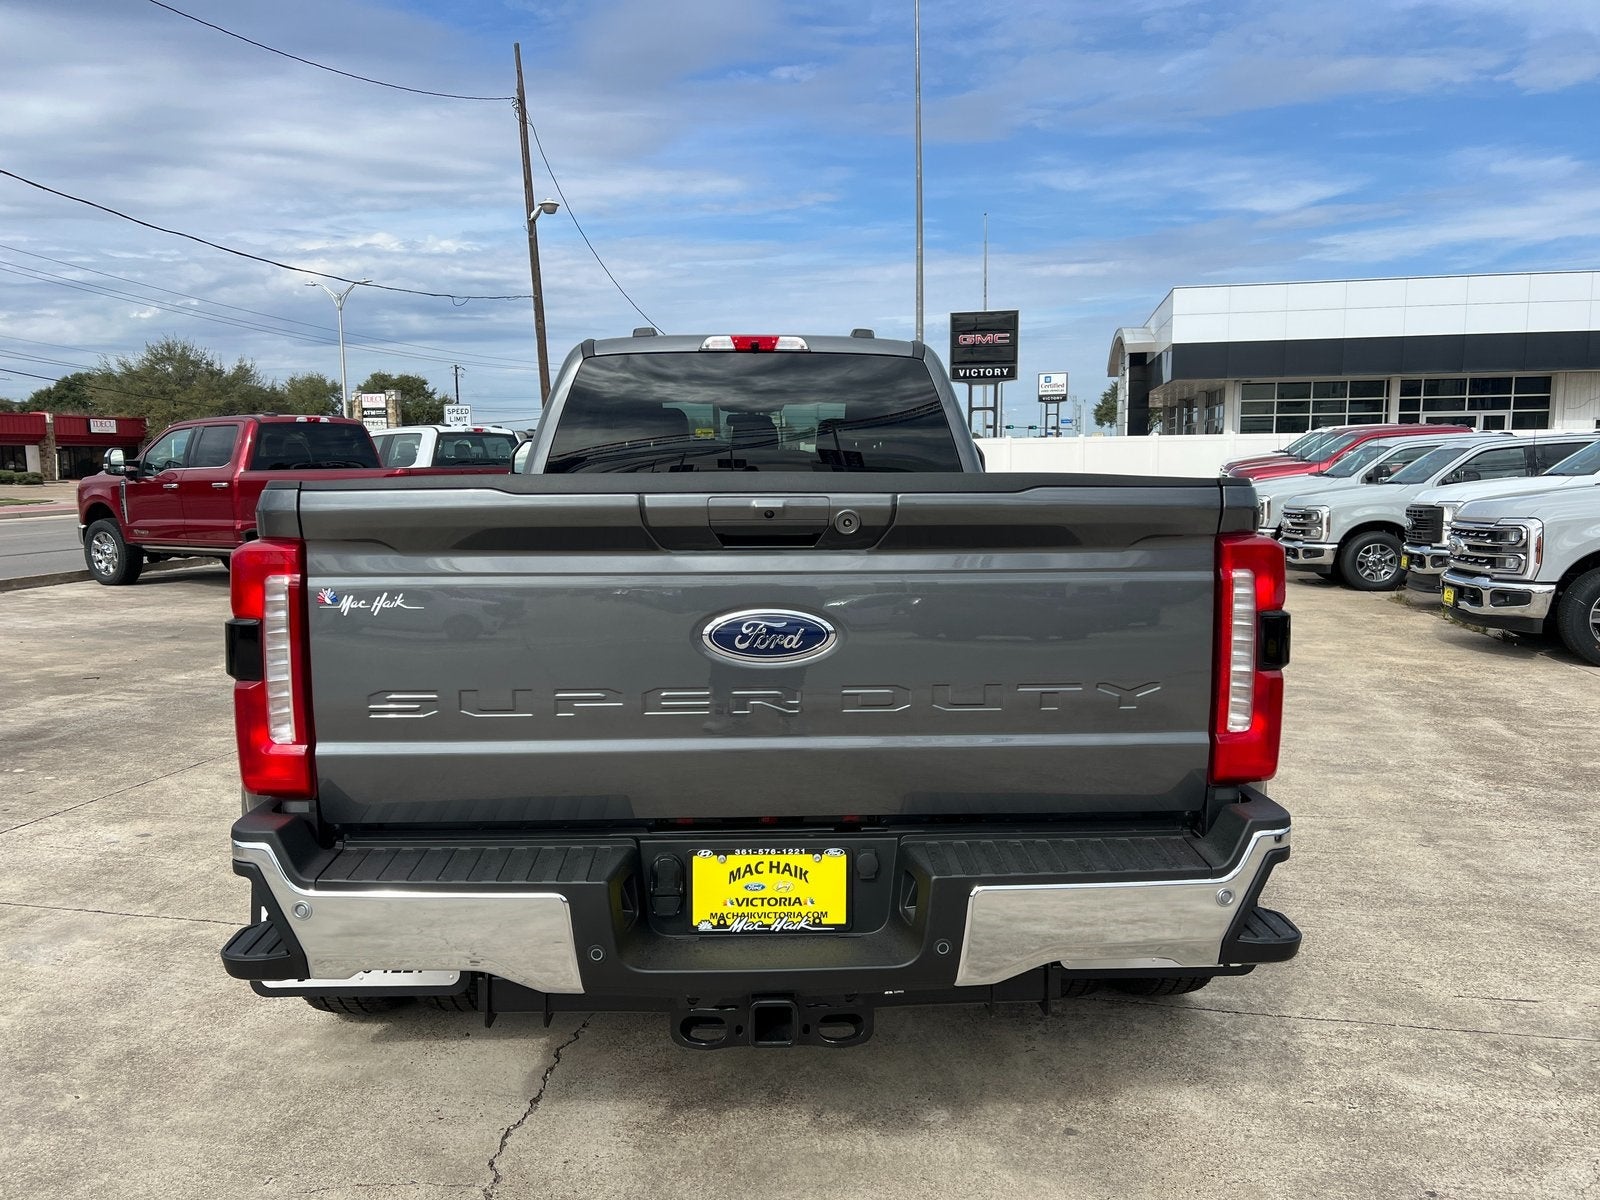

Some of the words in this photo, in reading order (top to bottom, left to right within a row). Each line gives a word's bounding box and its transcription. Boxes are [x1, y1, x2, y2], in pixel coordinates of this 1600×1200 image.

[958, 333, 1010, 345] GMC
[958, 368, 1009, 377] VICTORY
[338, 594, 371, 616] Mac
[370, 592, 406, 616] Haik
[734, 620, 806, 651] Ford
[367, 687, 800, 719] SUPER
[841, 681, 1162, 713] DUTY
[728, 861, 765, 884] MAC
[768, 860, 809, 884] HAIK
[735, 896, 803, 907] VICTORIA
[728, 916, 769, 932] Mac
[769, 915, 814, 932] Haik
